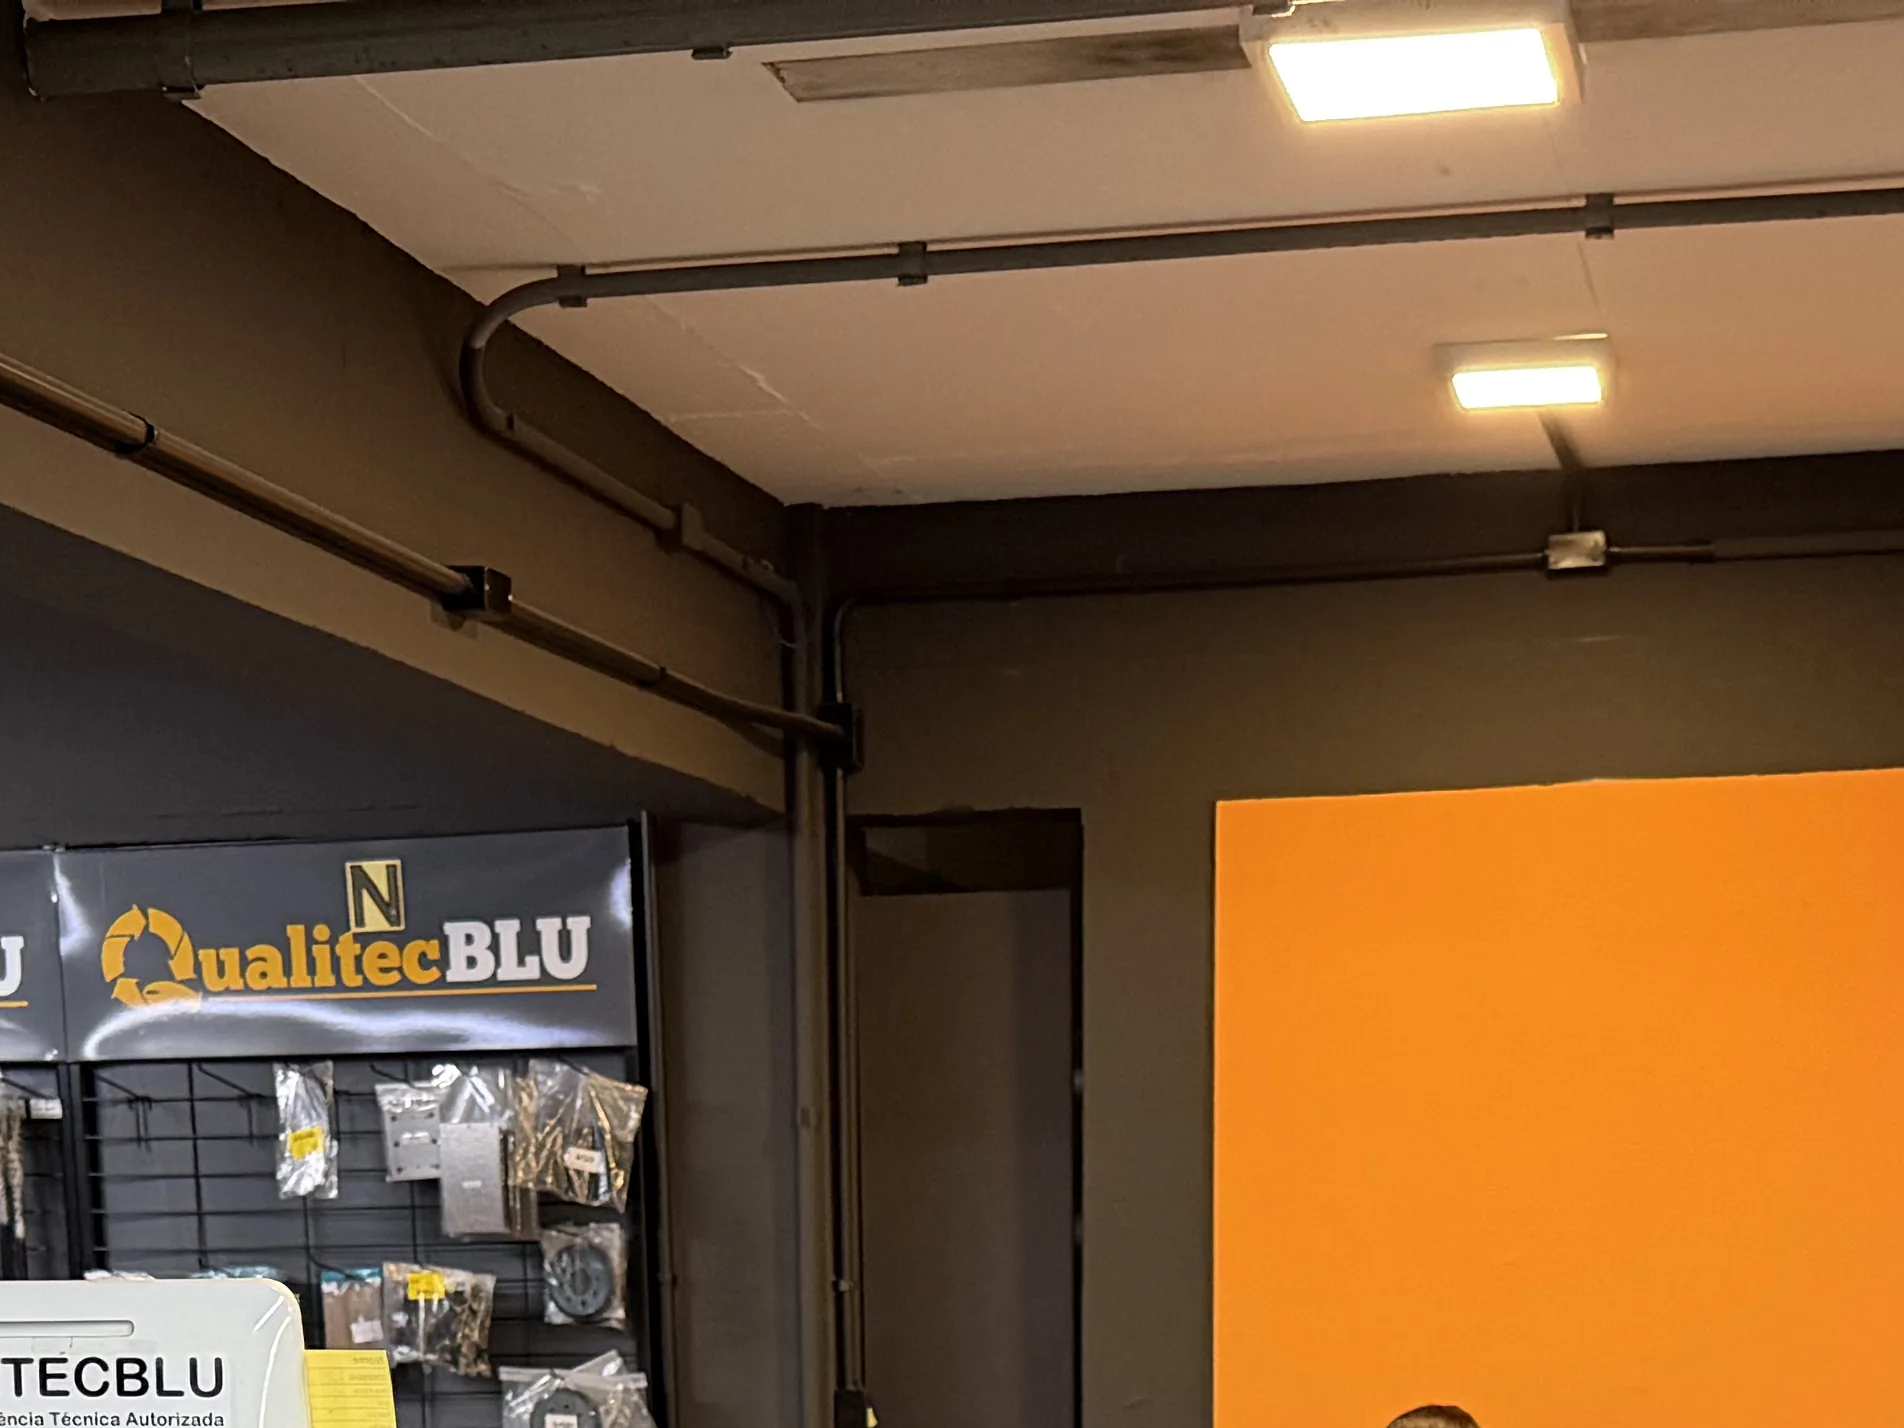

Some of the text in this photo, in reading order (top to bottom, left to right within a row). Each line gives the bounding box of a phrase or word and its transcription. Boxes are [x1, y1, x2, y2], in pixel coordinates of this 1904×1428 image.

[349, 863, 403, 928] N
[101, 903, 591, 1008] QualitecBLU
[49, 1411, 121, 1427] Técnica
[126, 1411, 225, 1428] Autorizada
